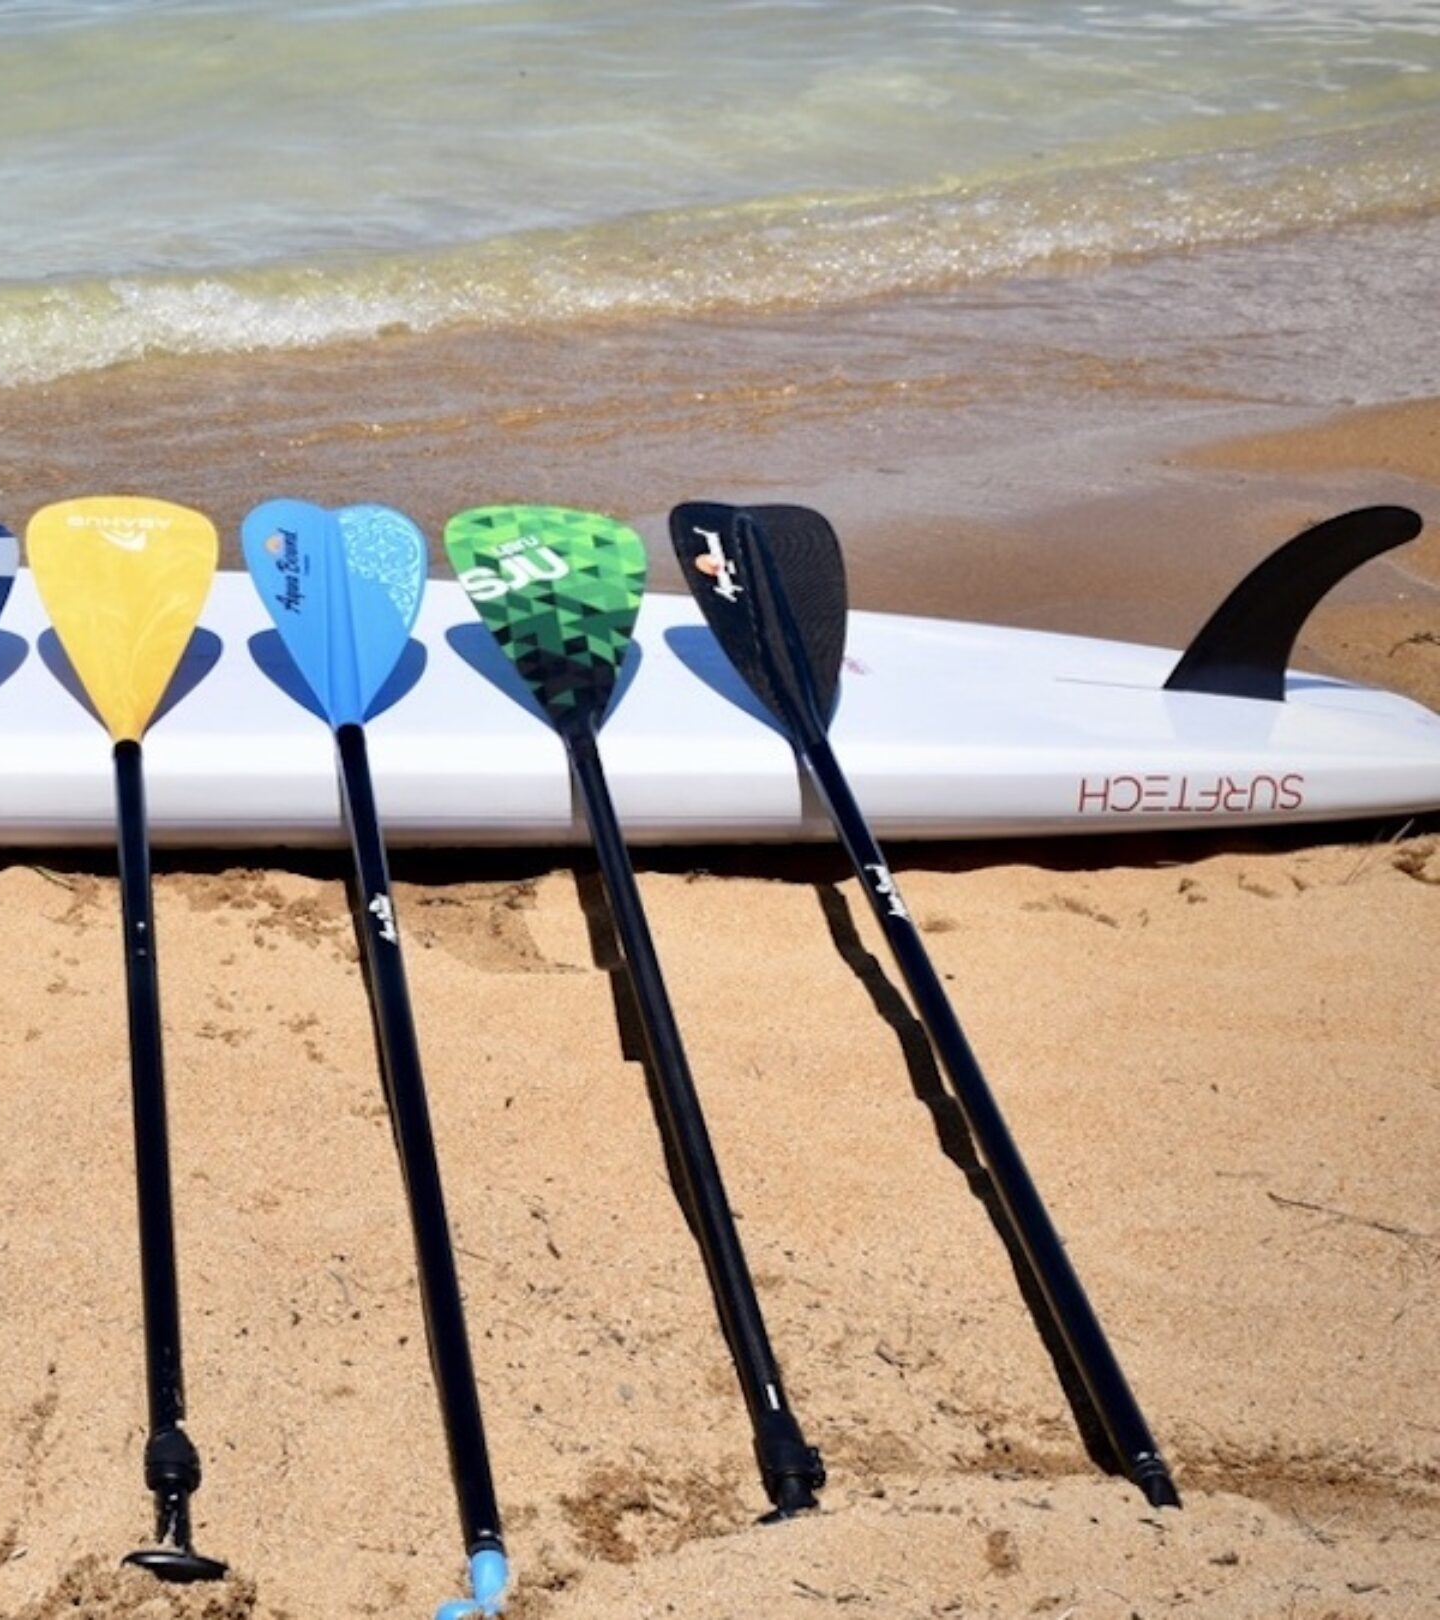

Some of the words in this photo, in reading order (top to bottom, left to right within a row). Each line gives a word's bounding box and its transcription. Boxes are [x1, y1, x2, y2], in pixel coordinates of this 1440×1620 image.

[276, 528, 301, 574] Bound
[275, 575, 305, 615] Aqua
[1077, 774, 1304, 813] SURFTECH
